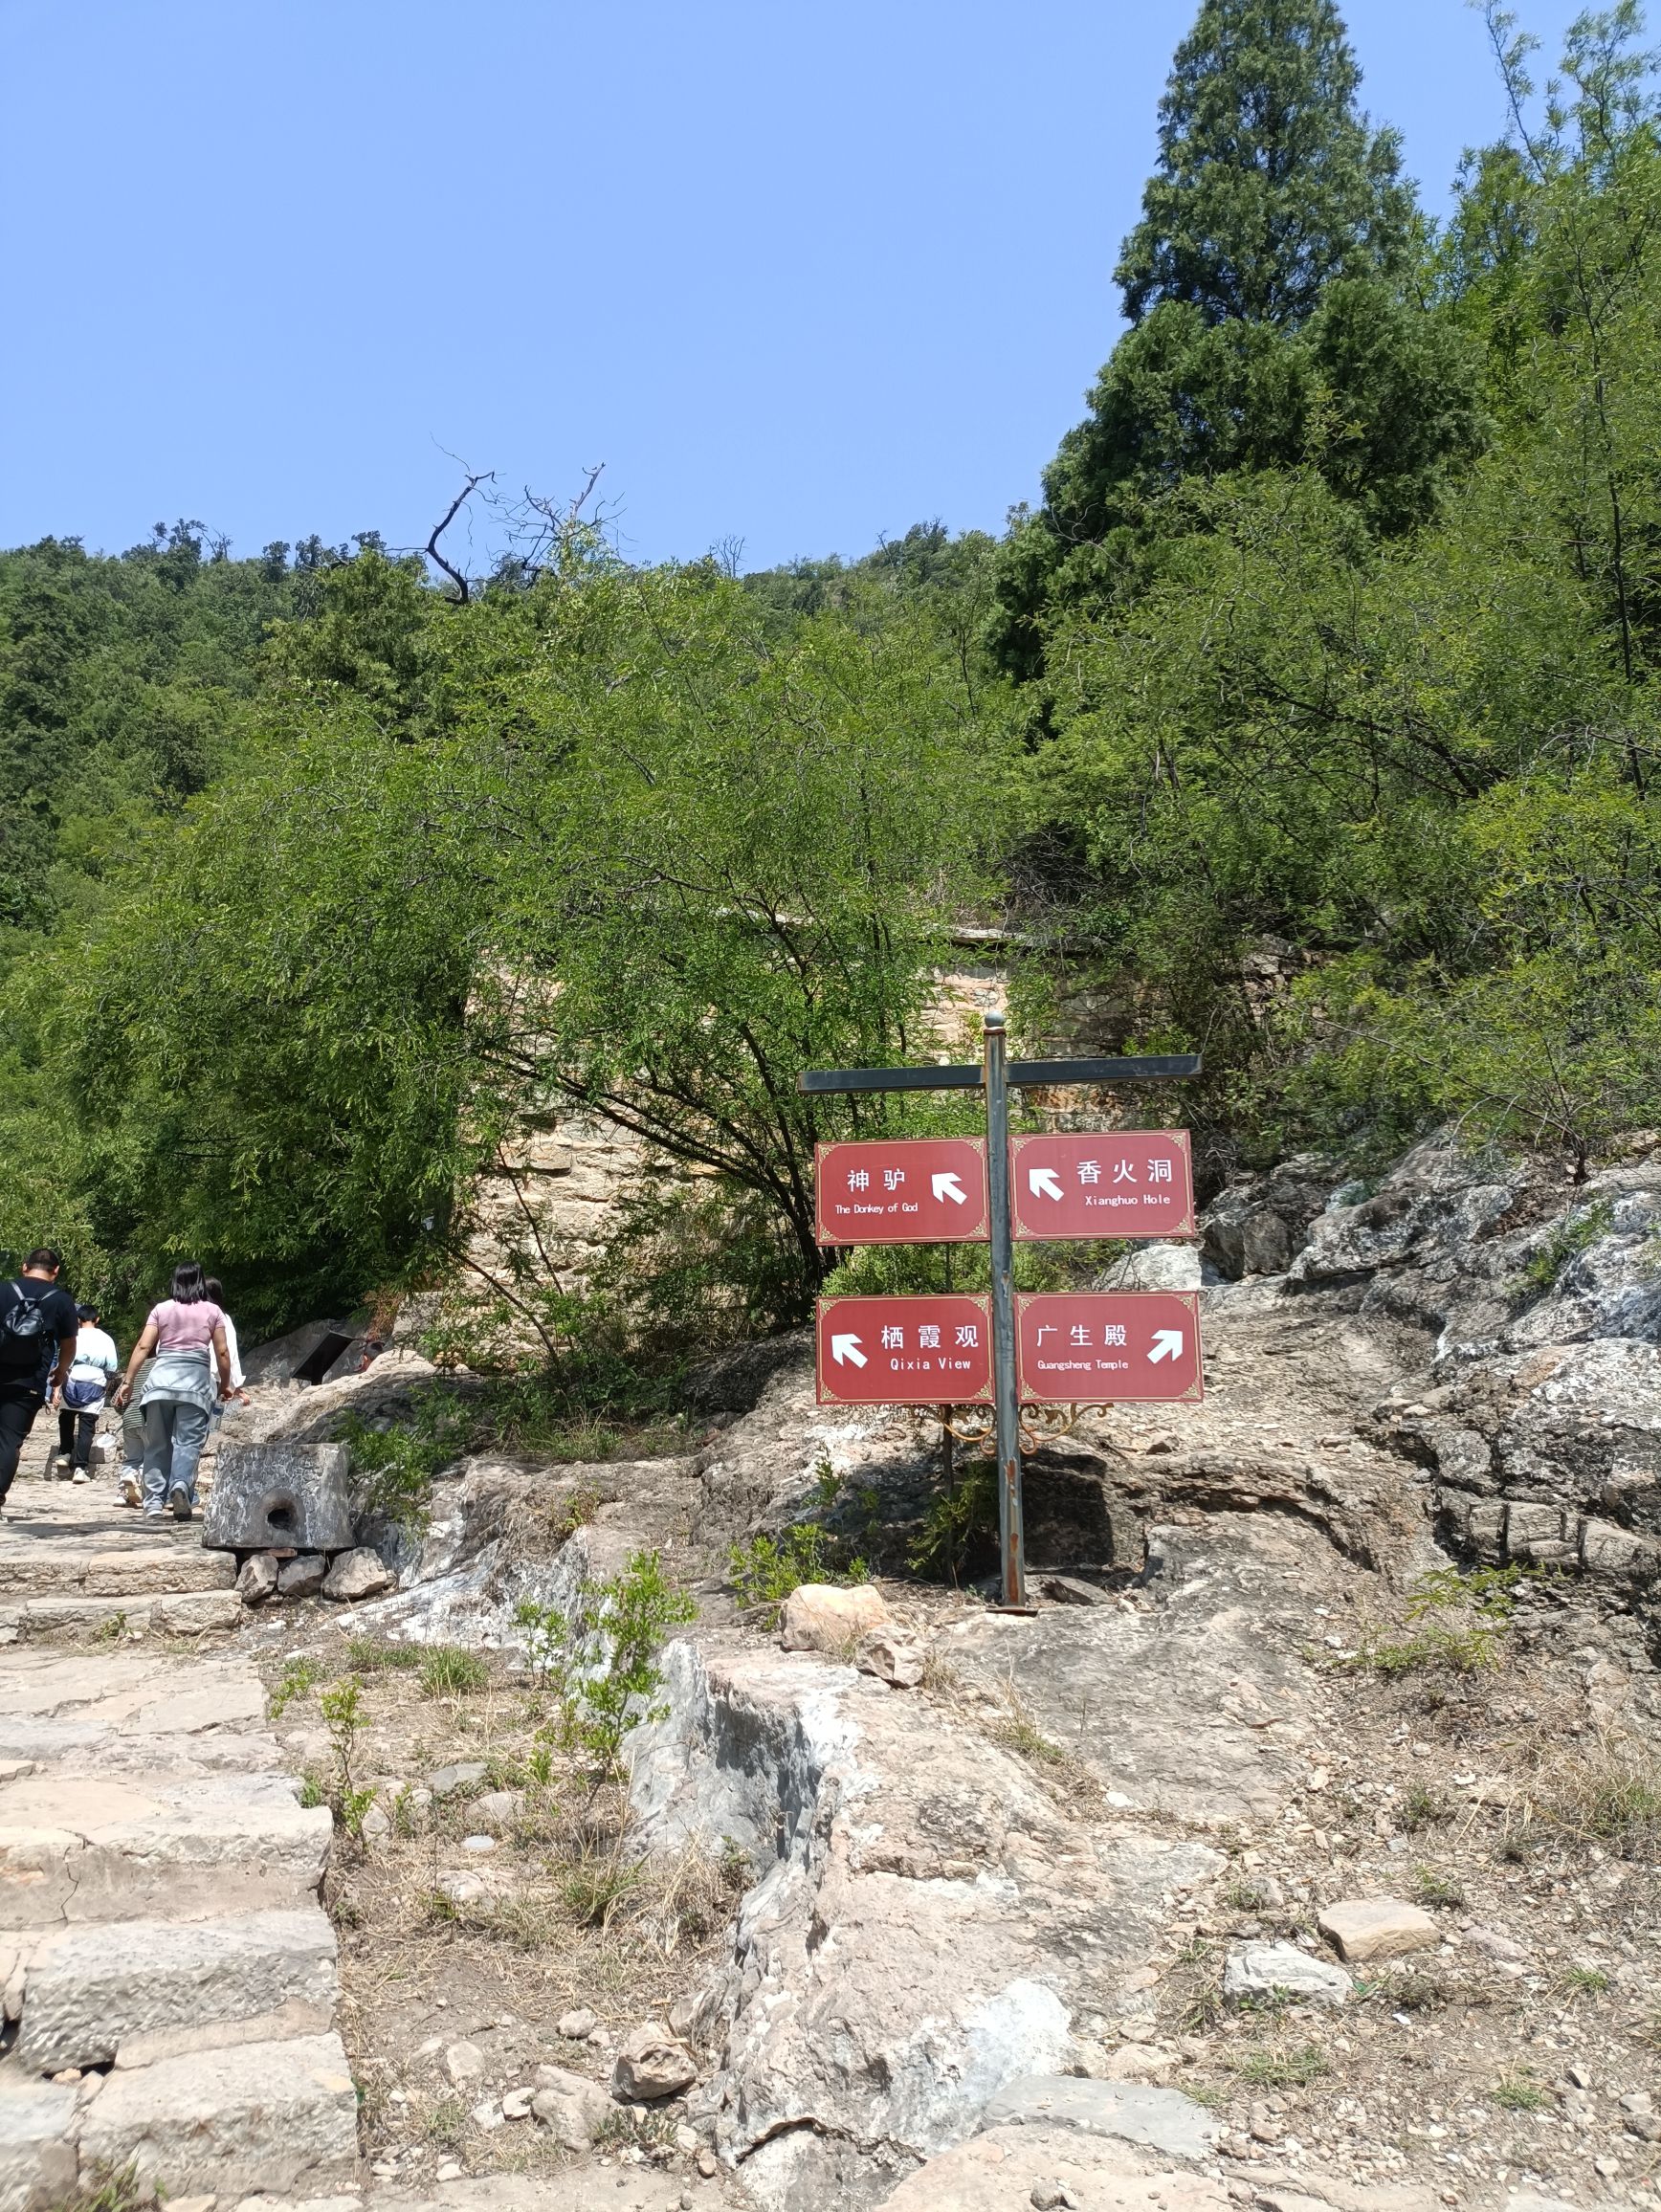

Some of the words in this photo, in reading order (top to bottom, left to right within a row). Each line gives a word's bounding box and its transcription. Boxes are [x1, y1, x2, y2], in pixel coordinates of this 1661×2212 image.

[847, 1168, 905, 1192] 神驴
[1076, 1159, 1172, 1184] 香火洞
[835, 1205, 851, 1214] The
[853, 1204, 884, 1214] Donkey
[887, 1203, 898, 1212] of
[901, 1202, 919, 1212] God
[1085, 1194, 1139, 1206] Xianghuo
[1142, 1194, 1171, 1205] Hole
[880, 1325, 979, 1349] 栖霞观
[1036, 1324, 1127, 1347] 广生殿
[890, 1358, 931, 1370] Qixia
[938, 1357, 971, 1369] View
[1037, 1360, 1092, 1371] Guangsheng
[1096, 1360, 1128, 1370] Temple
